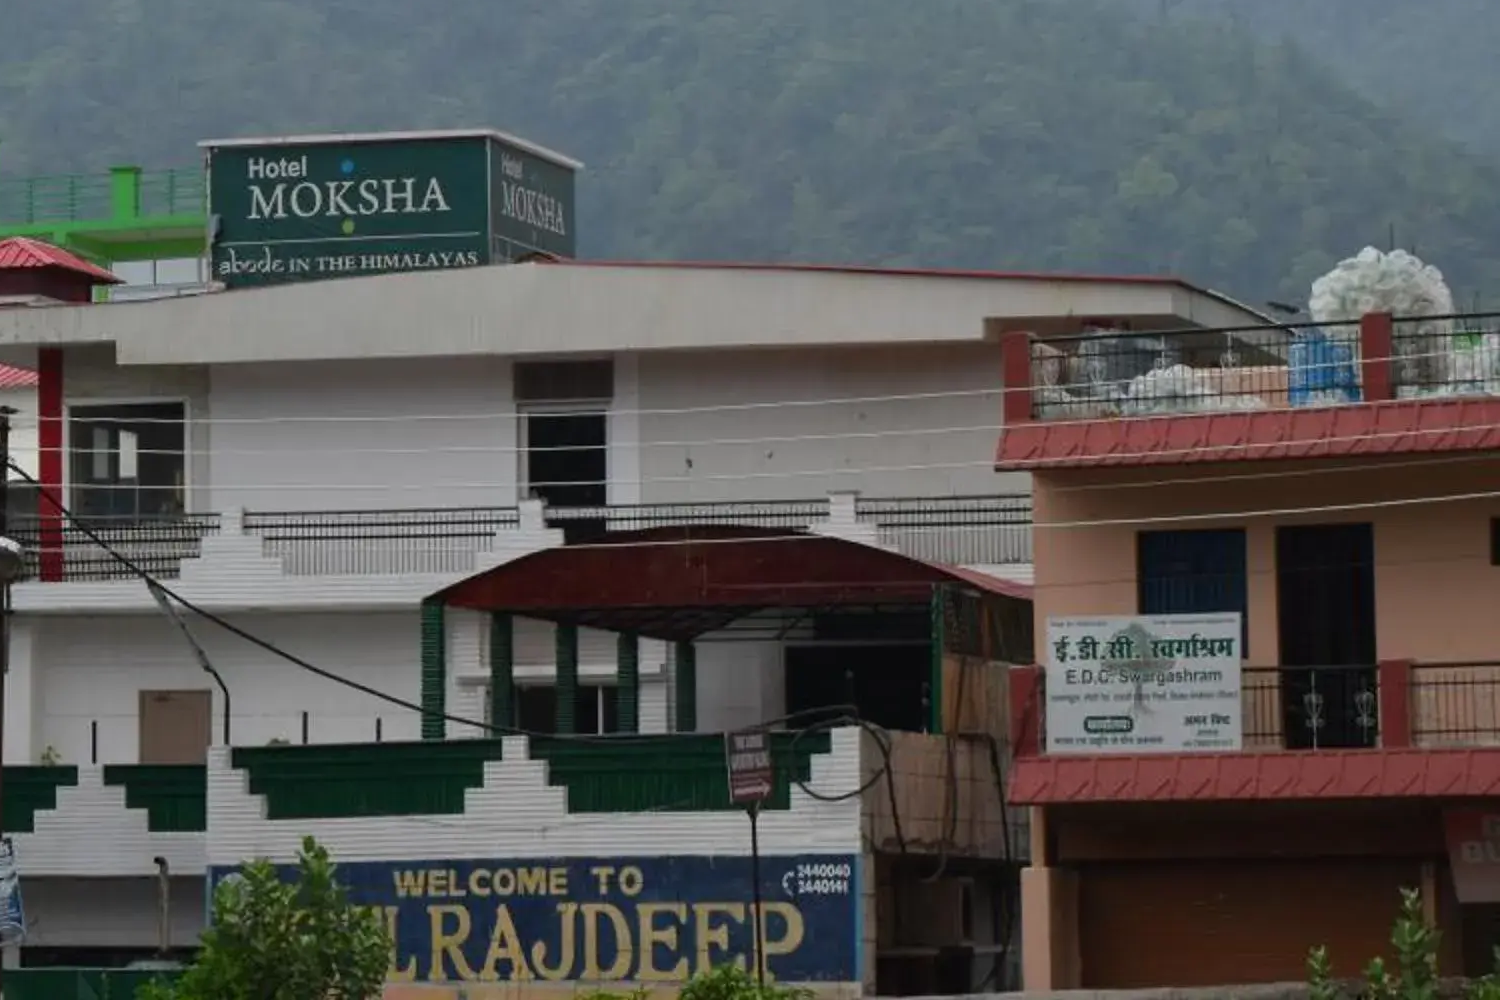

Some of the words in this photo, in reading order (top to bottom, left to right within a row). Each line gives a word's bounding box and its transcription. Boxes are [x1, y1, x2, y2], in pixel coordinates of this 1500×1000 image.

[248, 155, 308, 179] Hotel
[246, 177, 452, 220] MOKSHA
[501, 180, 566, 236] MOKSHA
[289, 257, 309, 273] IN
[316, 255, 357, 271] THE
[360, 251, 479, 269] HIMALAYAS
[1118, 668, 1223, 687] Swargashram
[393, 867, 569, 898] WELCOME
[590, 866, 645, 897] TO
